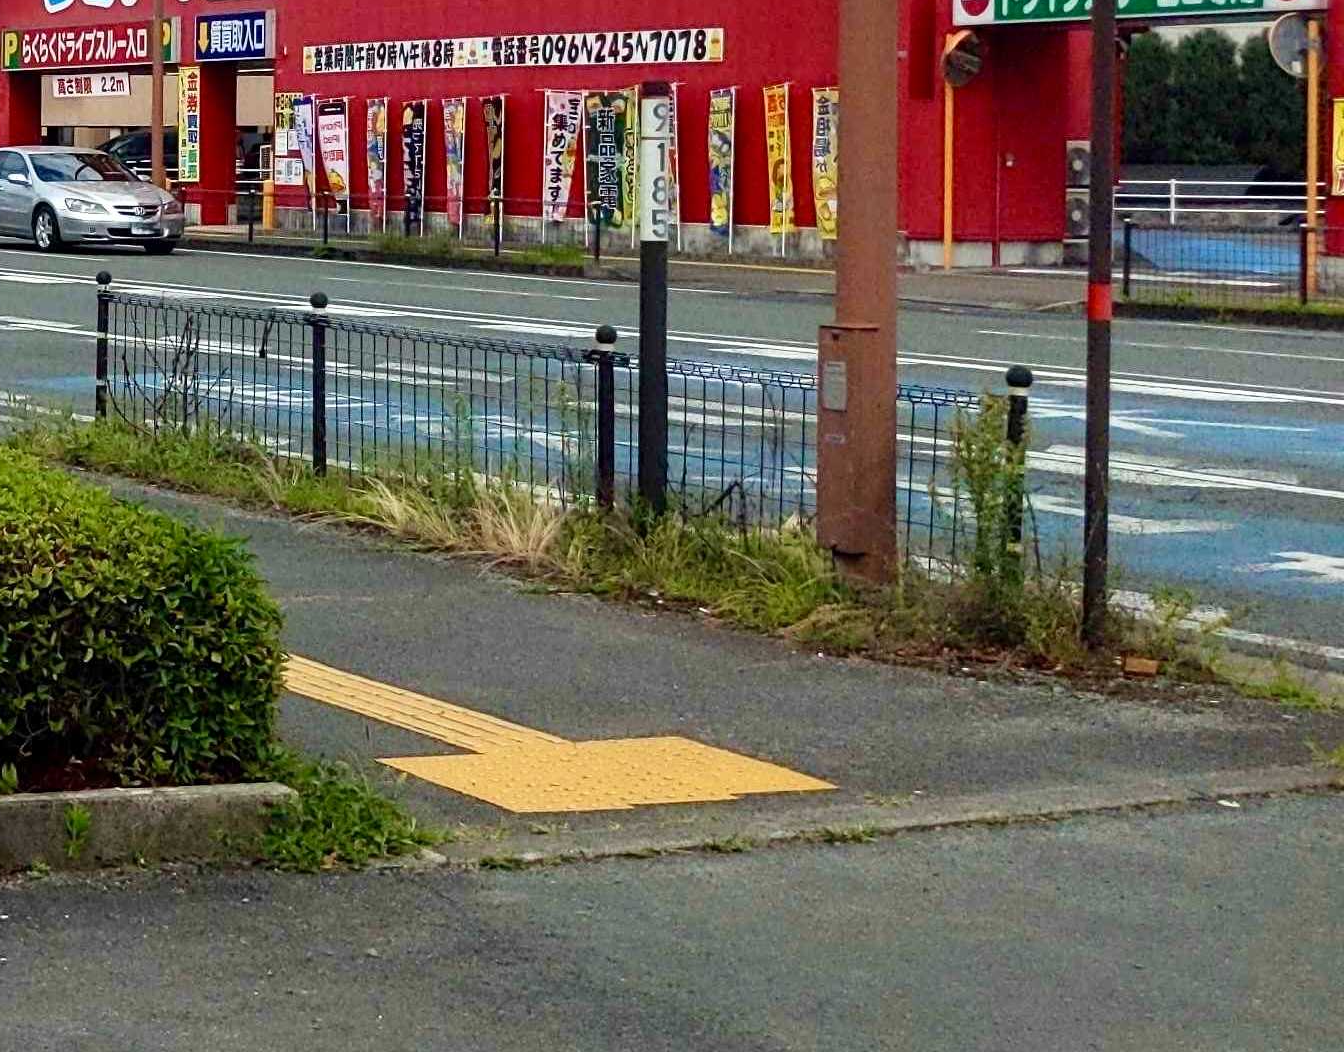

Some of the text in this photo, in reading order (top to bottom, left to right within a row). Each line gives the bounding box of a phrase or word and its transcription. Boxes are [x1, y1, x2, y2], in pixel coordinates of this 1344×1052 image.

[22, 28, 148, 64] らくらくドライブスルー入口
[101, 76, 125, 93] 2.2m
